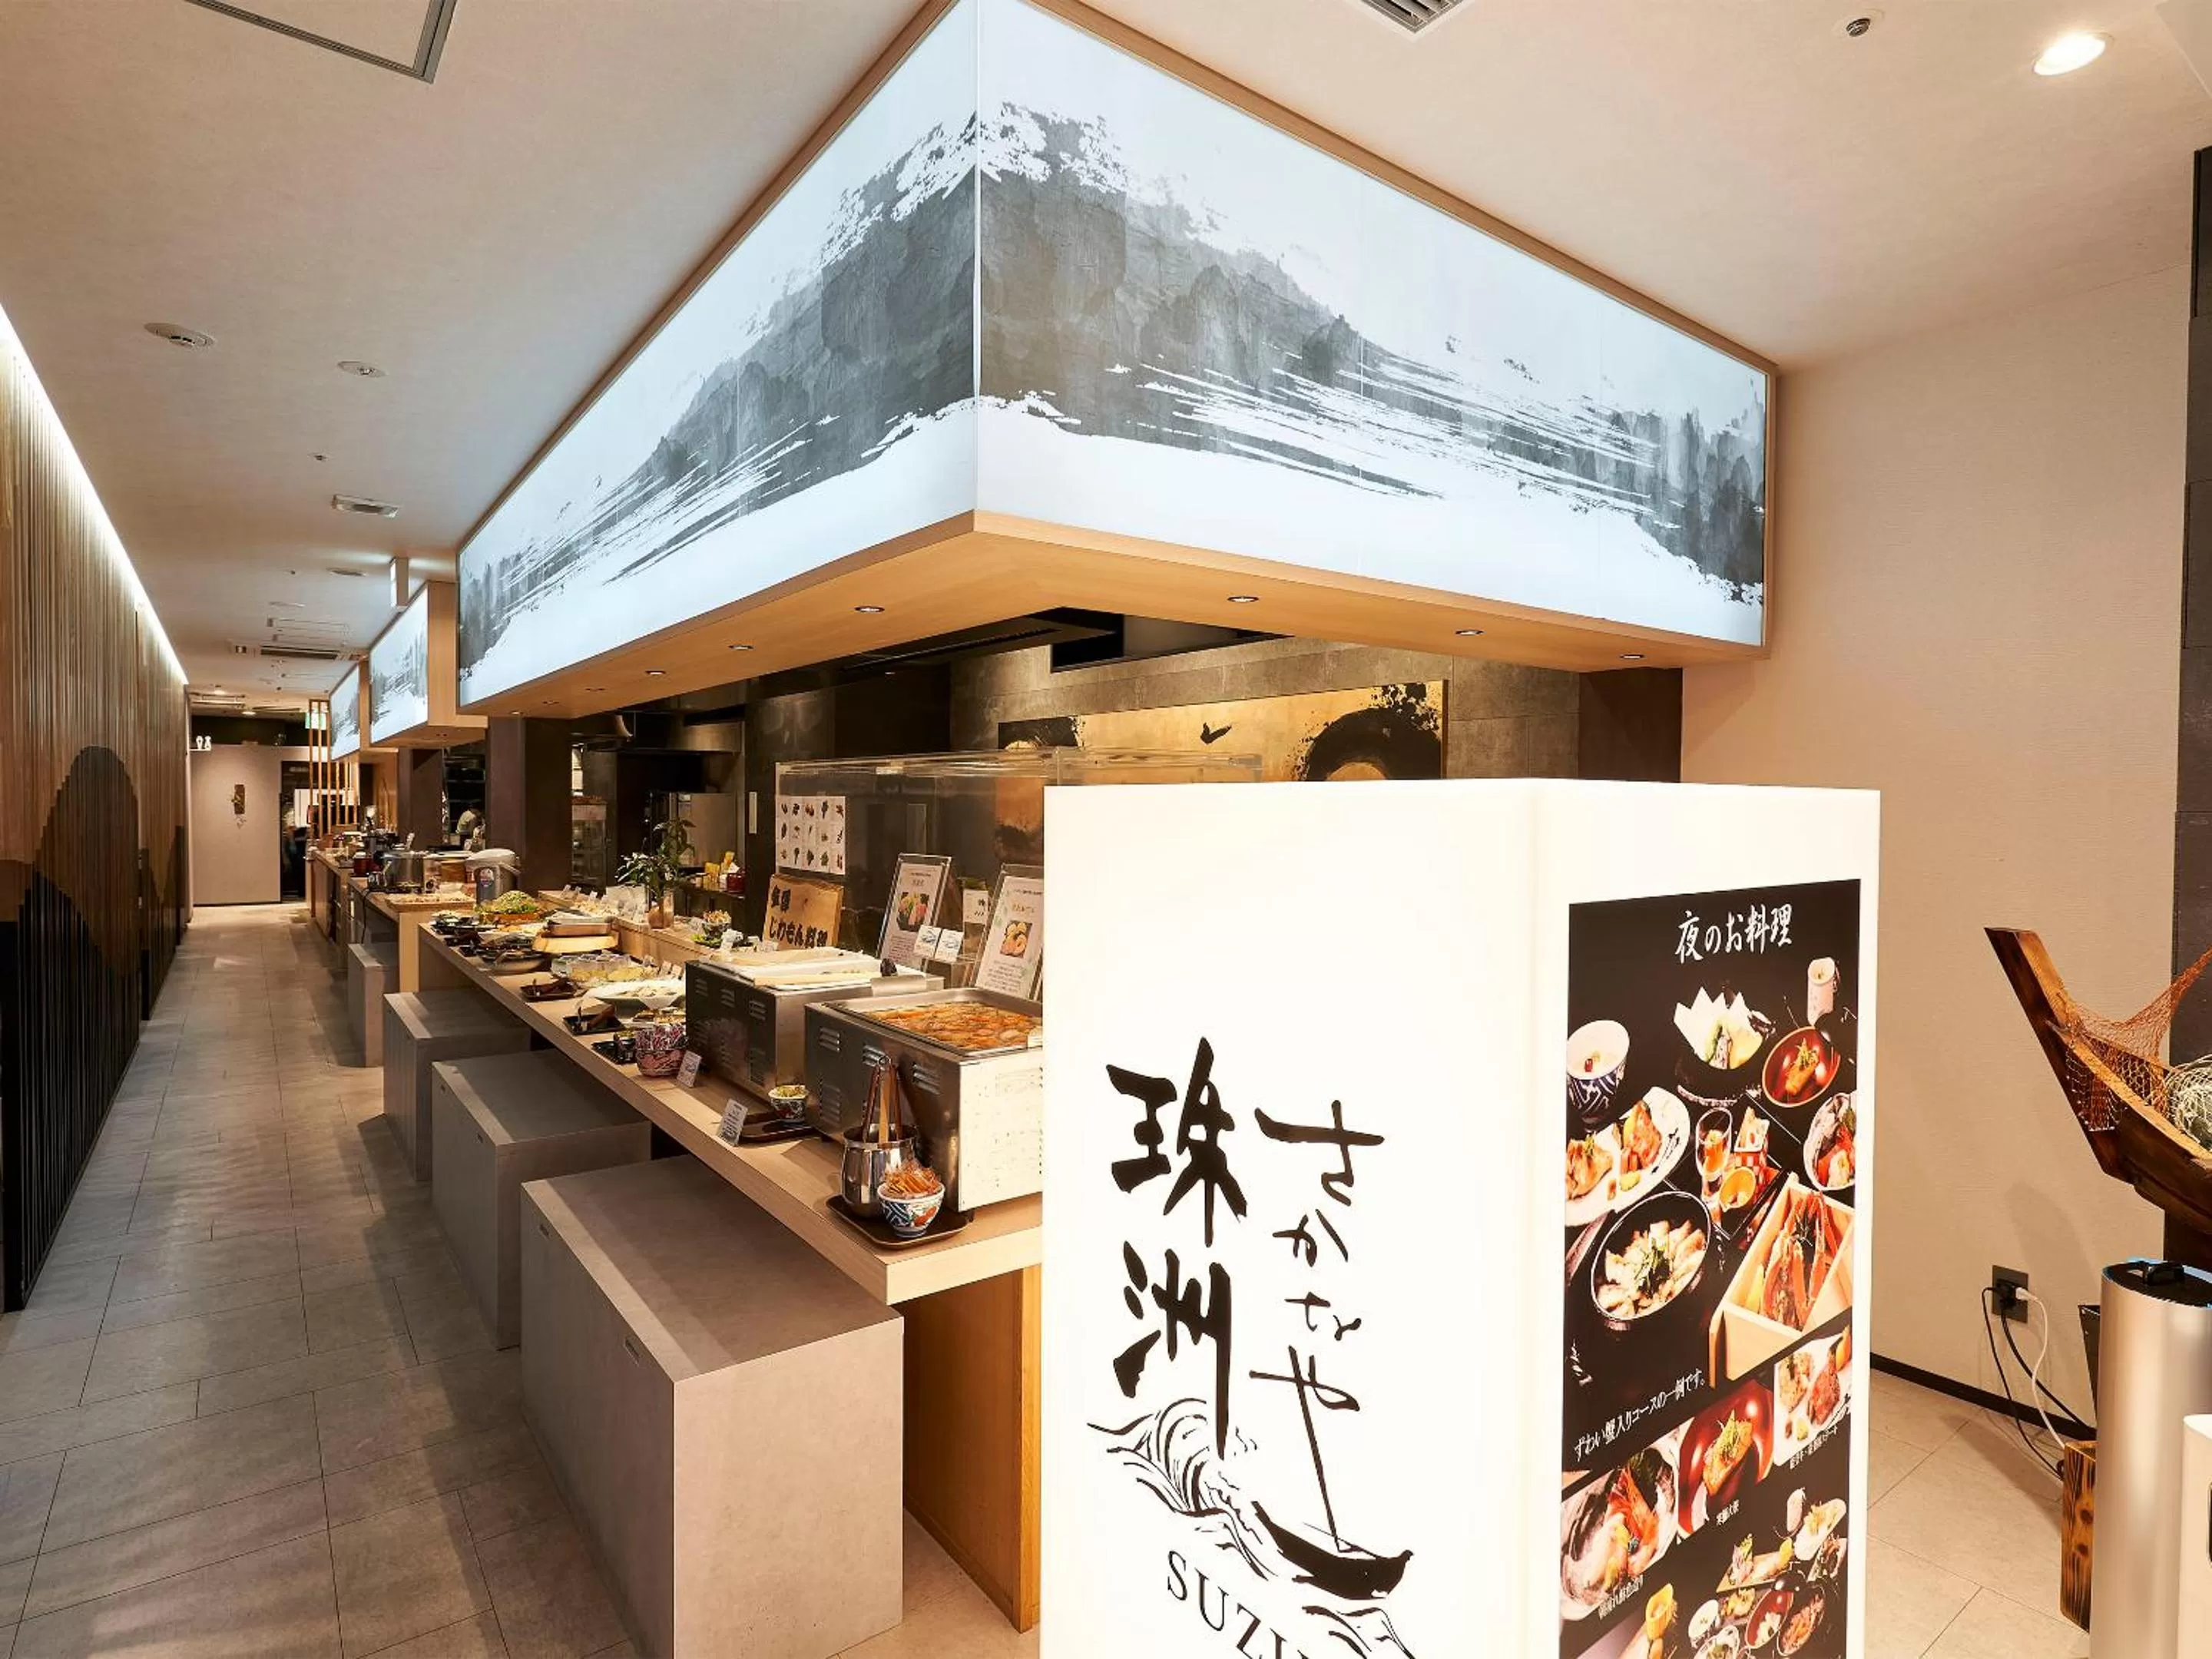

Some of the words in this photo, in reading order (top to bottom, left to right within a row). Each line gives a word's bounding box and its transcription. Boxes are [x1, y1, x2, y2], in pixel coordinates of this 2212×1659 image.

[1674, 902, 1793, 964] 夜のお料理
[1105, 1037, 1247, 1459] 珠洲
[1249, 1099, 1386, 1413] さかなや
[1575, 1368, 1706, 1462] ずわい蟹入りコースの一例です。
